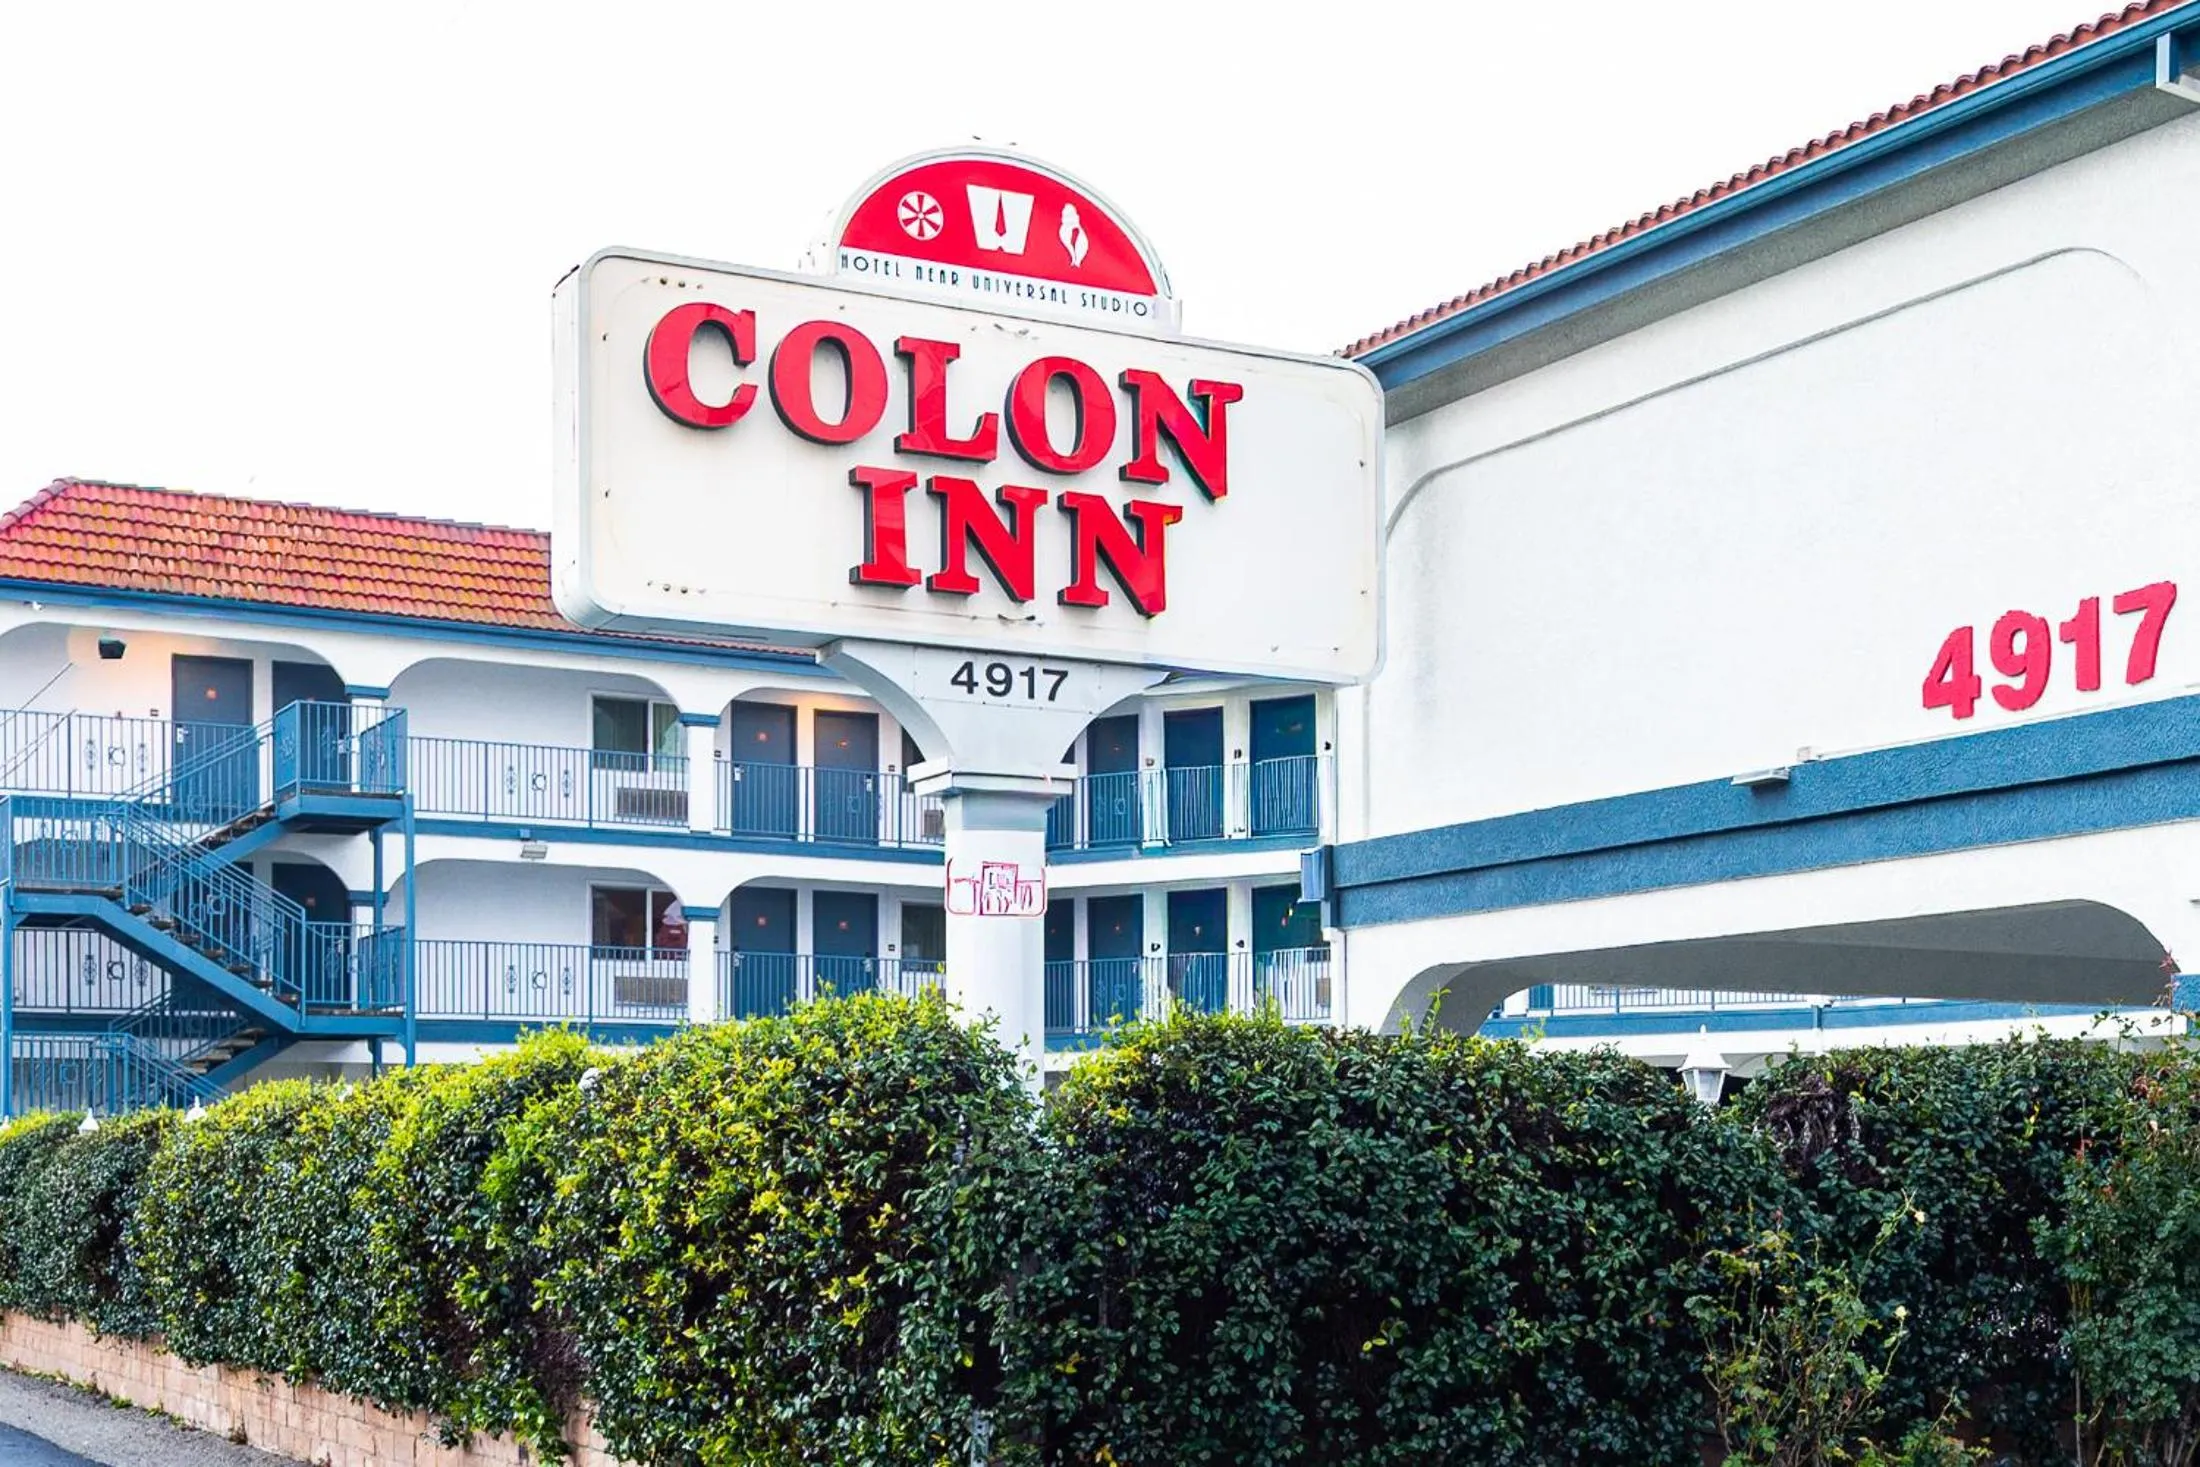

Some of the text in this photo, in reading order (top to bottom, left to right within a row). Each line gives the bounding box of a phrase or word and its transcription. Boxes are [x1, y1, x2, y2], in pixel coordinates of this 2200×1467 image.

[840, 254, 900, 277] HOTEL
[915, 265, 959, 286] NEAR
[972, 274, 1067, 305] UNIVERSAL
[643, 301, 1243, 504] COLON
[849, 464, 1183, 620] INN
[950, 661, 1069, 702] 4917
[1922, 580, 2177, 720] 4917
